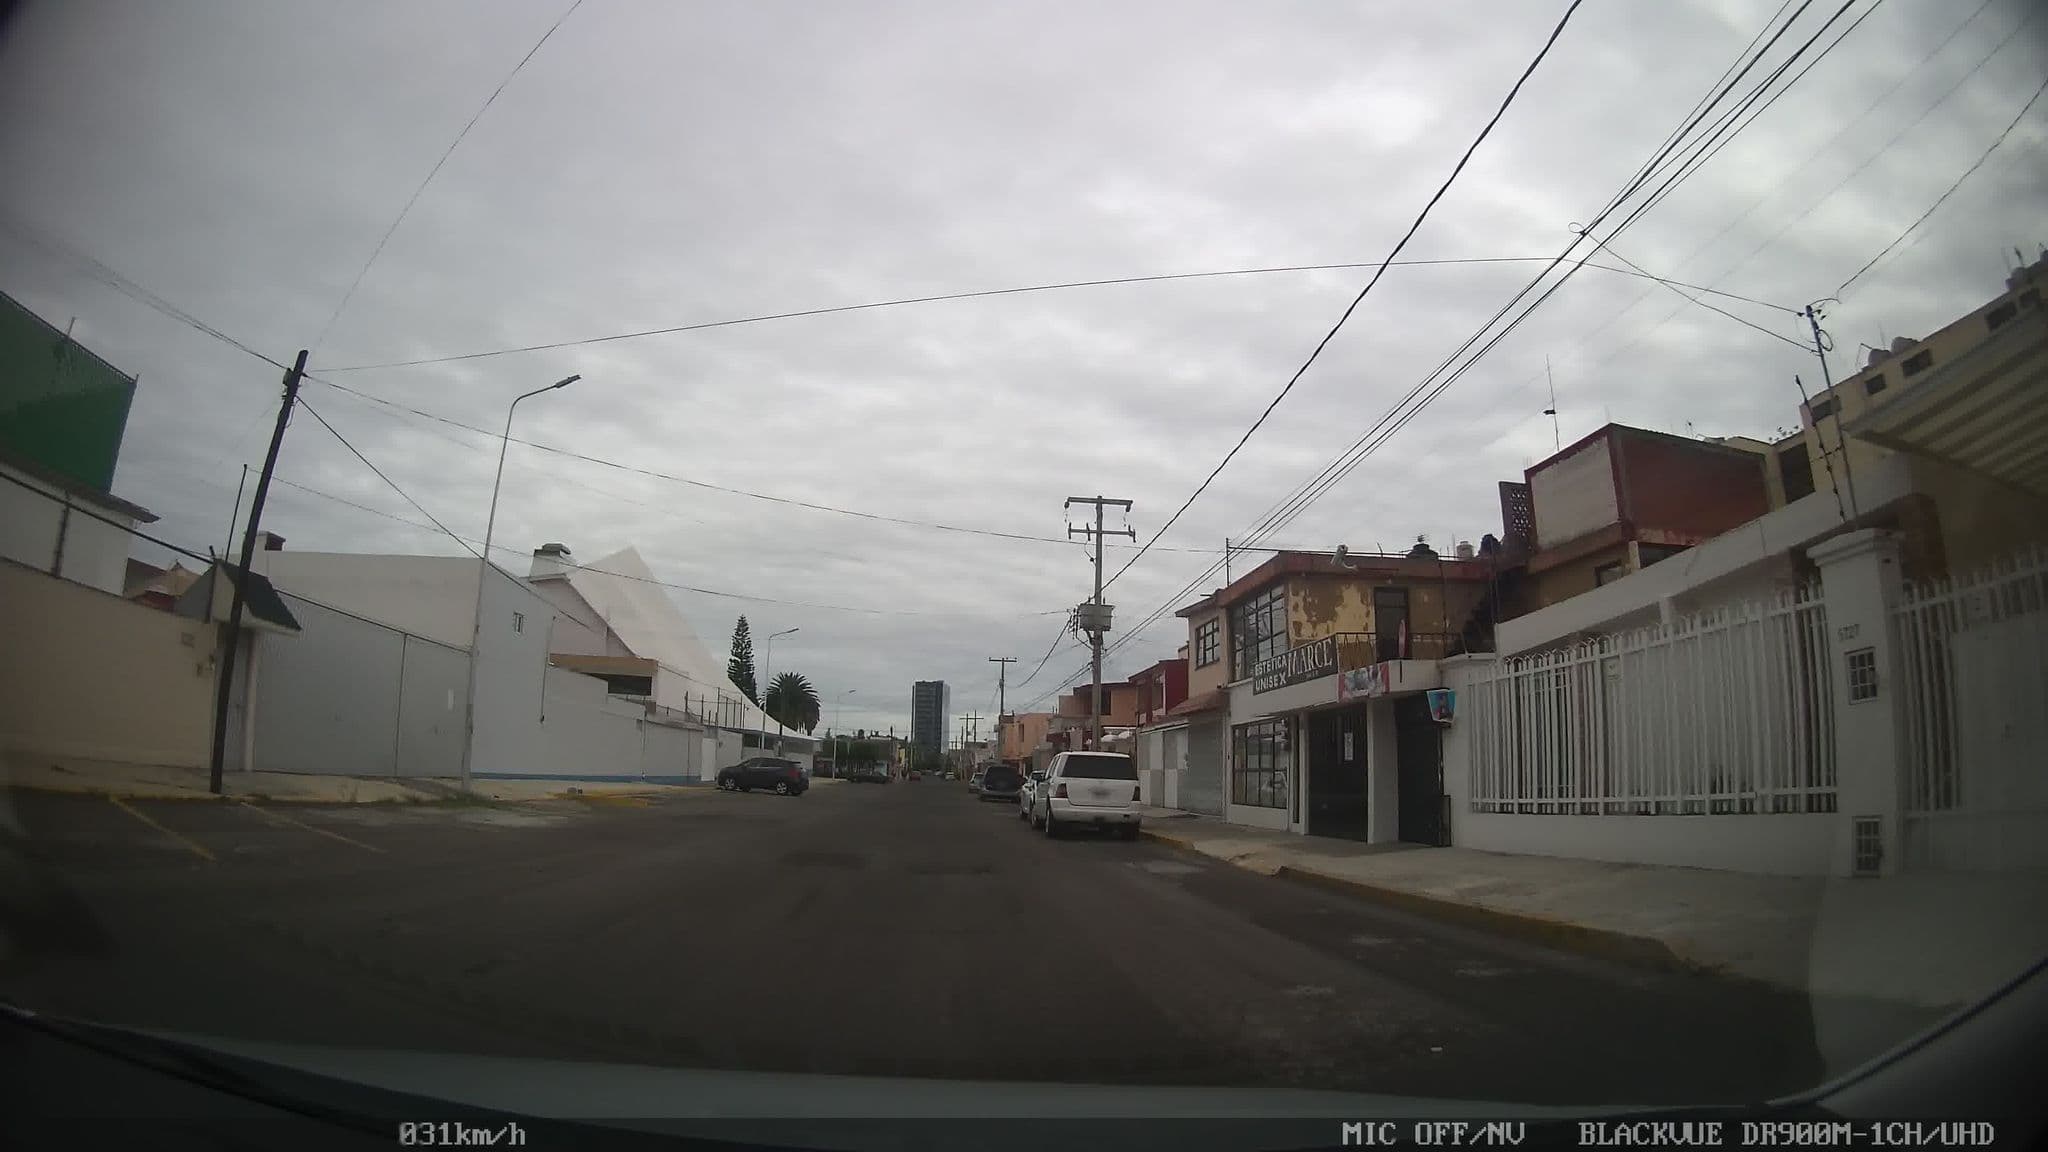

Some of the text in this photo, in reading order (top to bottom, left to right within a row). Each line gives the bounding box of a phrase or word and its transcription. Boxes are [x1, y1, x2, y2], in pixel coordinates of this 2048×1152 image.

[1255, 654, 1287, 676] ESTETICA
[1287, 639, 1333, 678] MARCE
[1255, 671, 1287, 692] UNISEX
